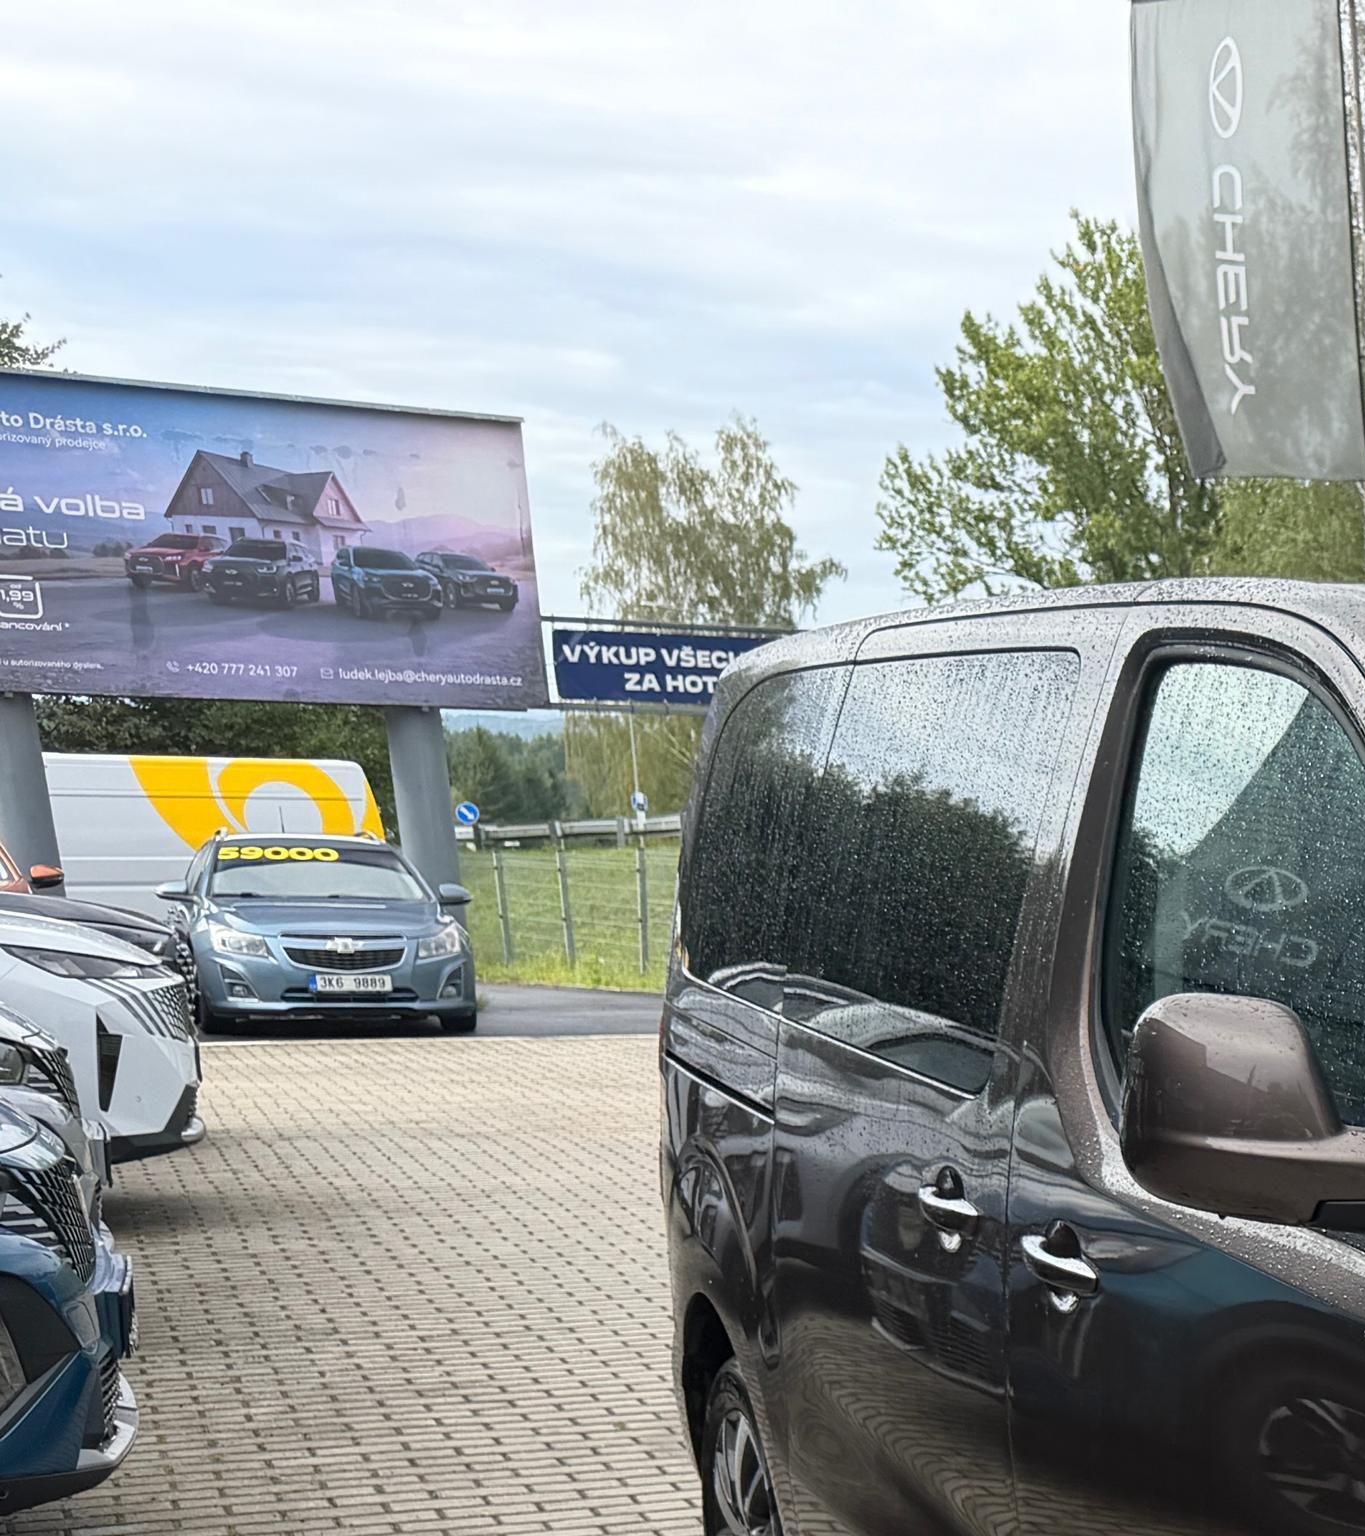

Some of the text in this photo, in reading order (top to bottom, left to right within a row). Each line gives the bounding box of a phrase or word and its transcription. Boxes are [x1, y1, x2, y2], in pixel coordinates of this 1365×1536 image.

[29, 412, 97, 434] Drásta
[102, 422, 148, 438] s.r.o.
[56, 438, 107, 451] prodejce
[33, 494, 146, 520] volba
[0, 526, 69, 549] atu
[0, 589, 34, 602] 1,99
[562, 641, 657, 666] VÝKUP
[186, 662, 298, 678] +420 777 241 307
[624, 672, 661, 692] ZA
[217, 846, 340, 862] 59000
[319, 976, 344, 989] 3K6
[353, 977, 386, 990] 9889
